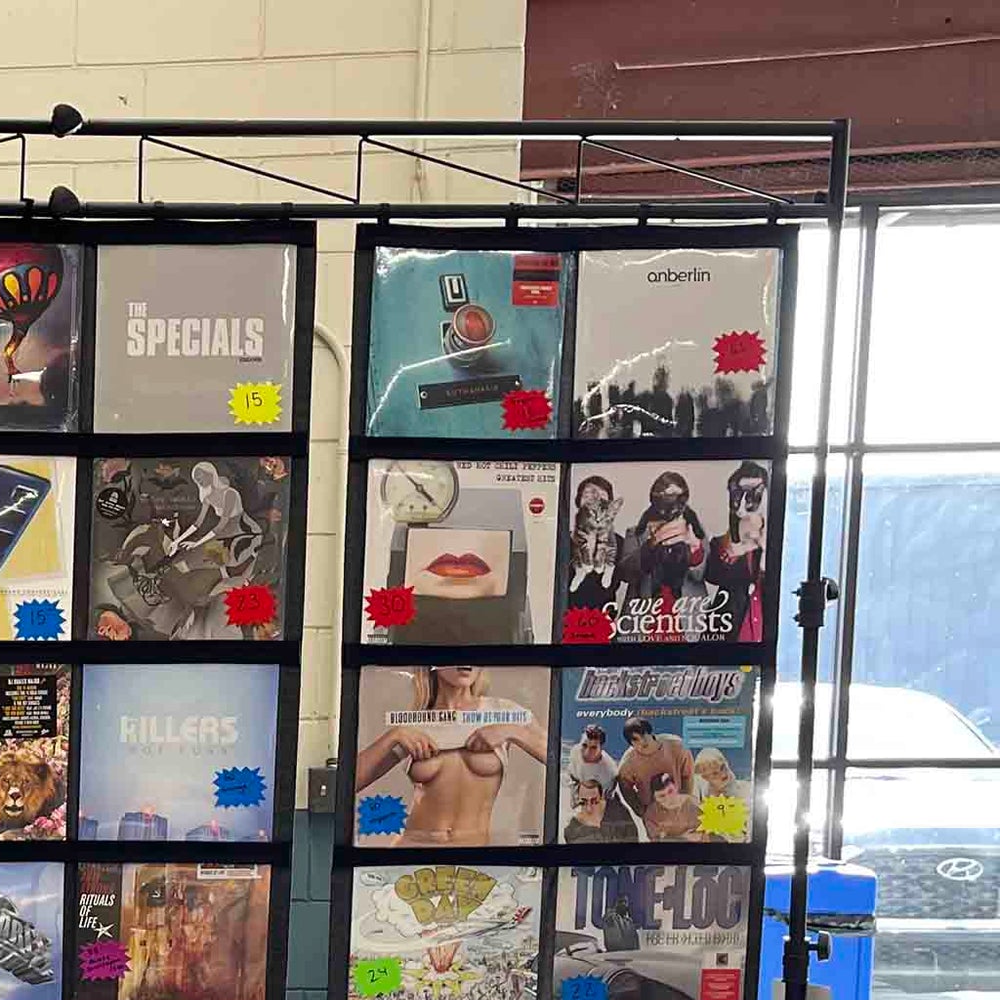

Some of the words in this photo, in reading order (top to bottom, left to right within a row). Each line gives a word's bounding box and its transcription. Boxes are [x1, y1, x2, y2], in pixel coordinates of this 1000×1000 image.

[647, 267, 711, 283] anberlin
[127, 301, 148, 317] THE
[126, 317, 264, 357] SPECIALS
[244, 391, 263, 410] 15
[629, 596, 664, 616] we
[672, 590, 730, 614] are
[576, 708, 634, 719] everybody
[79, 893, 116, 907] RITUALS
[79, 906, 92, 918] OF
[78, 916, 98, 929] LIFE
